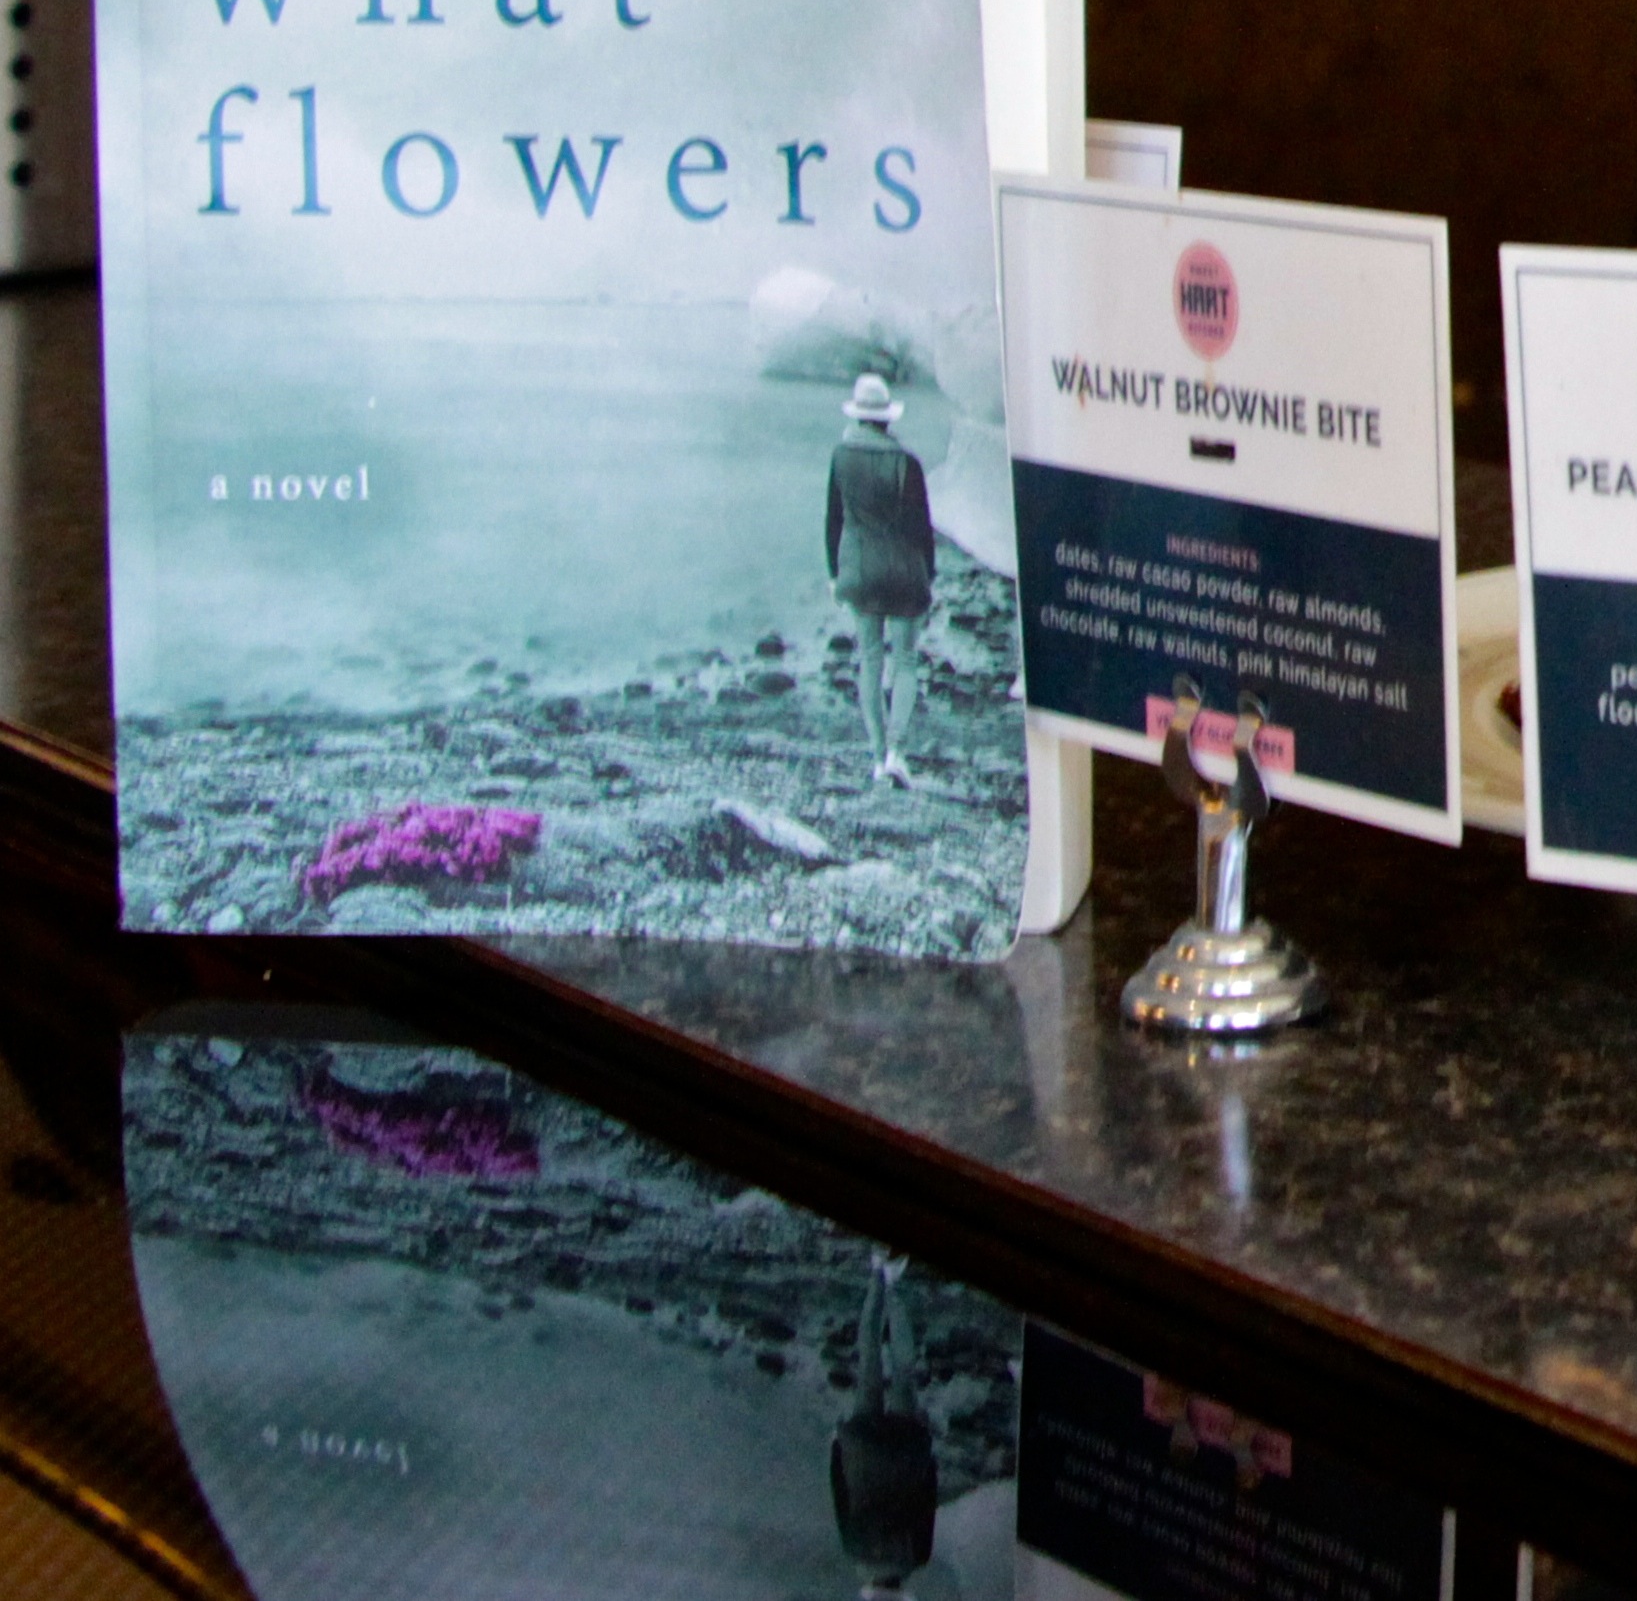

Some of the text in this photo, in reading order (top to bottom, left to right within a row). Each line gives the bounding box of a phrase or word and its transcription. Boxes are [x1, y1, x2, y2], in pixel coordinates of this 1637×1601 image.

[196, 82, 923, 233] flowers
[1181, 279, 1229, 320] HART
[1052, 357, 1381, 448] WALNUT BROWNIE BITE
[210, 464, 371, 500] a novel
[1065, 574, 1141, 615] shredded
[1146, 598, 1257, 641] unsweetened
[1345, 640, 1376, 667] raw
[1108, 555, 1137, 580] raw
[1142, 561, 1191, 592] cacao
[1269, 588, 1299, 615] raw
[1128, 624, 1157, 650] raw
[1238, 649, 1273, 678] pink
[1279, 656, 1368, 702] himalayan
[1375, 681, 1407, 712] salt
